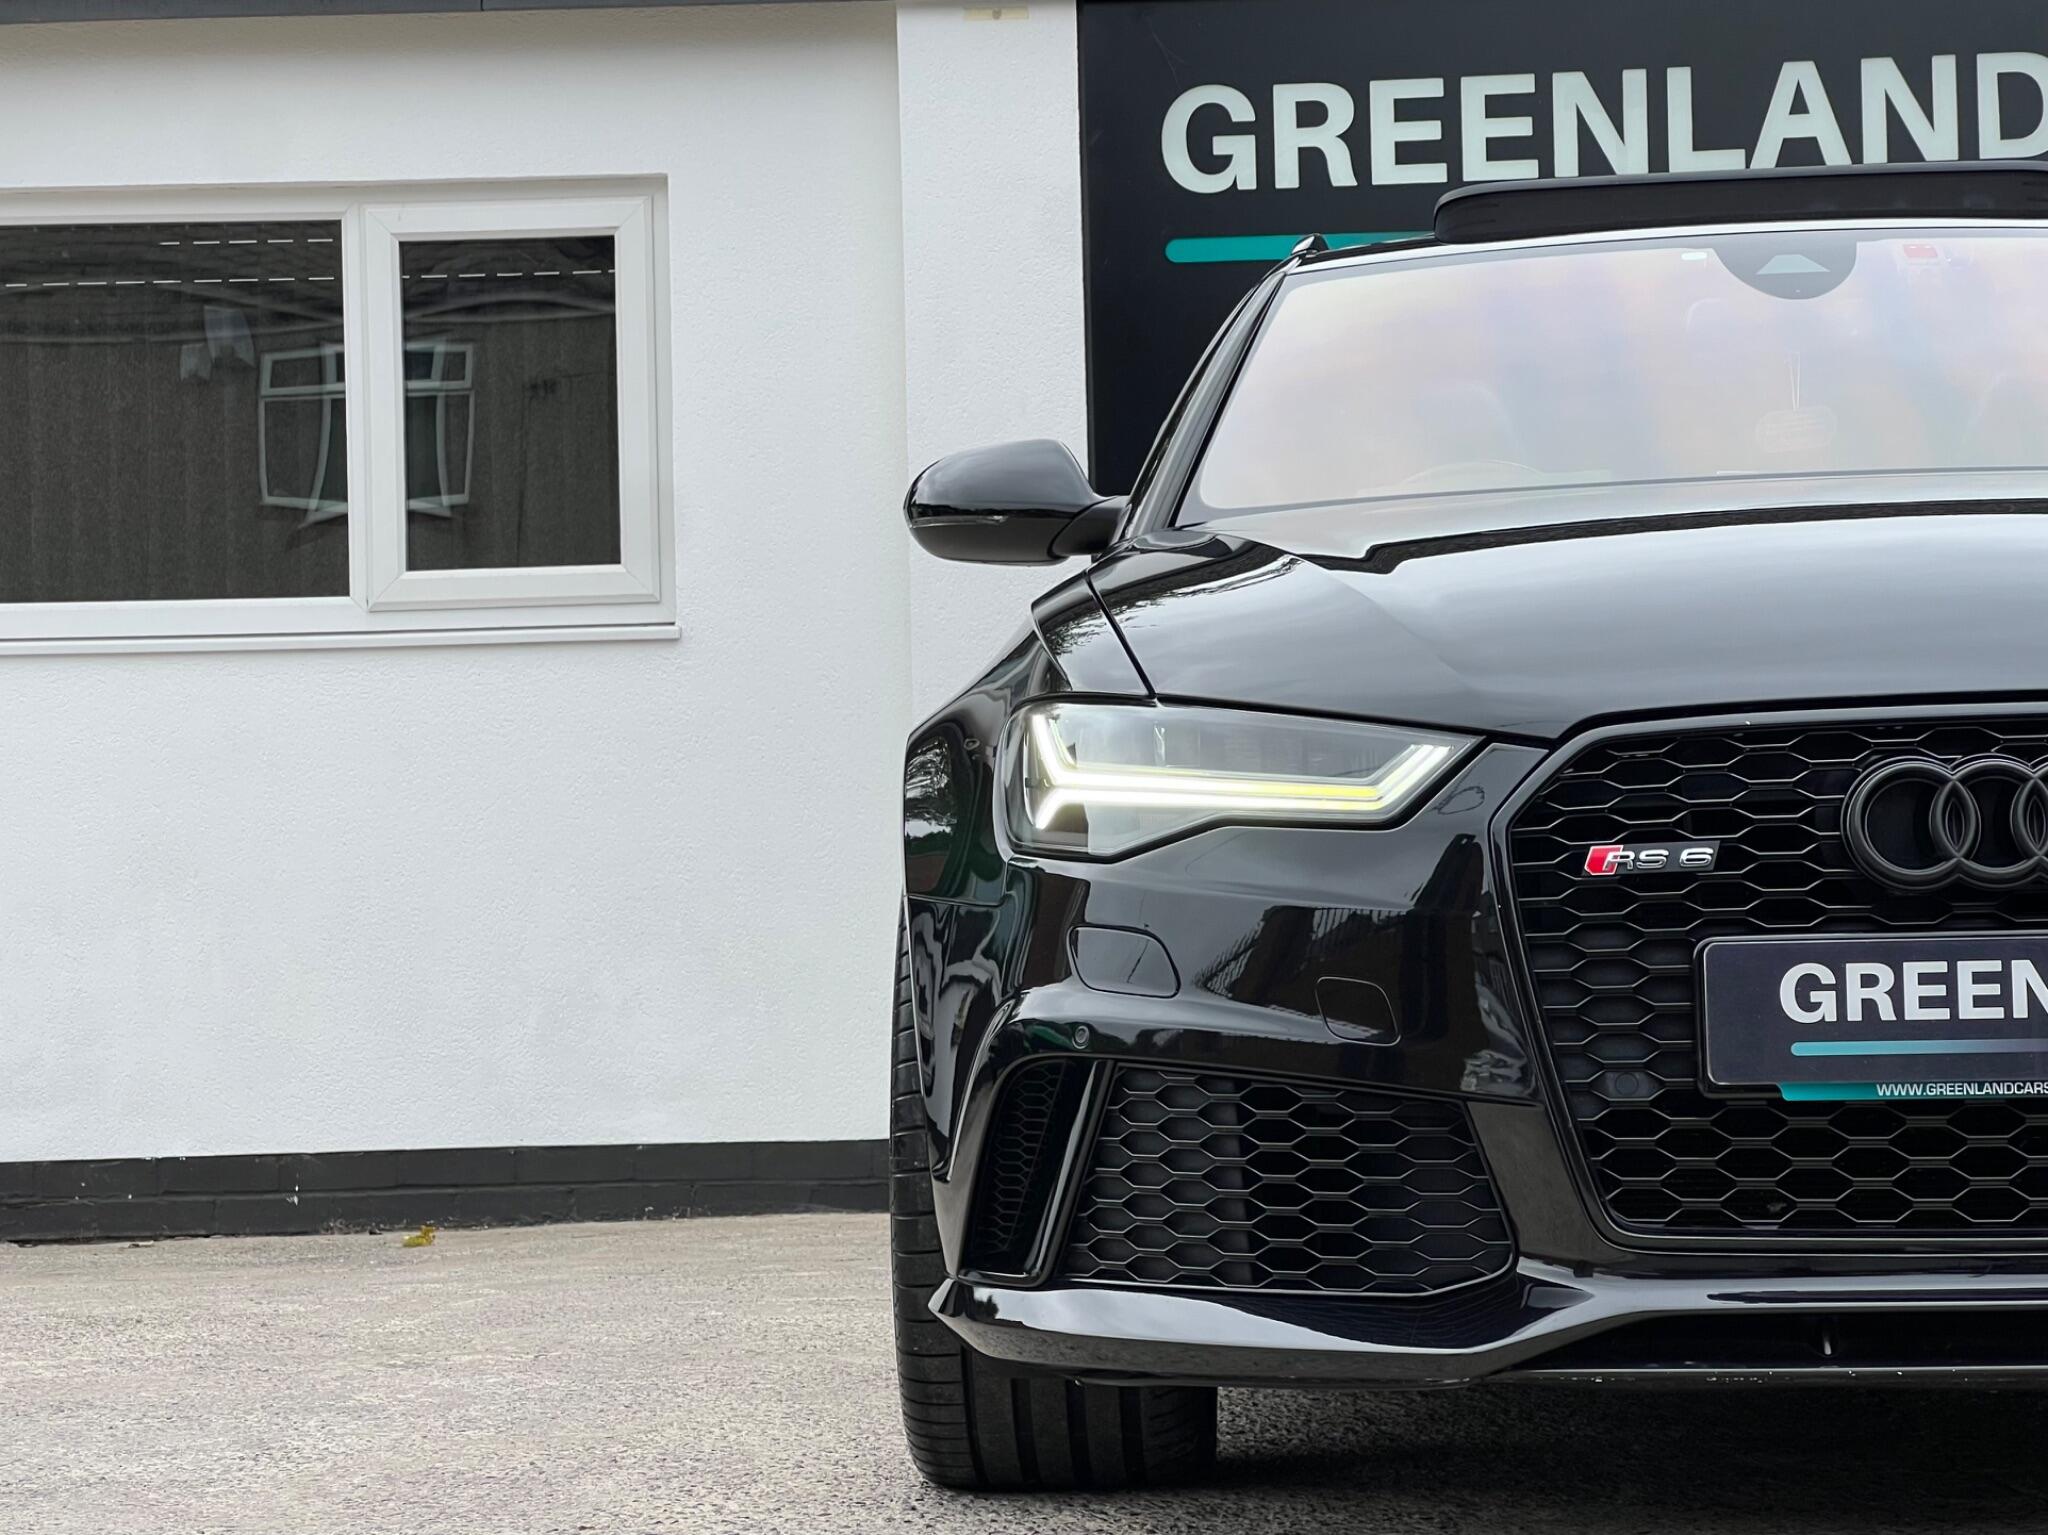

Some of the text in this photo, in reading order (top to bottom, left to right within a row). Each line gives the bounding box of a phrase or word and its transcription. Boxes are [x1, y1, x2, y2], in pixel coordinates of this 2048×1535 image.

[1161, 52, 2048, 194] GREENLAND
[1602, 847, 1714, 871] RS 6
[1779, 959, 2048, 1024] GREEN
